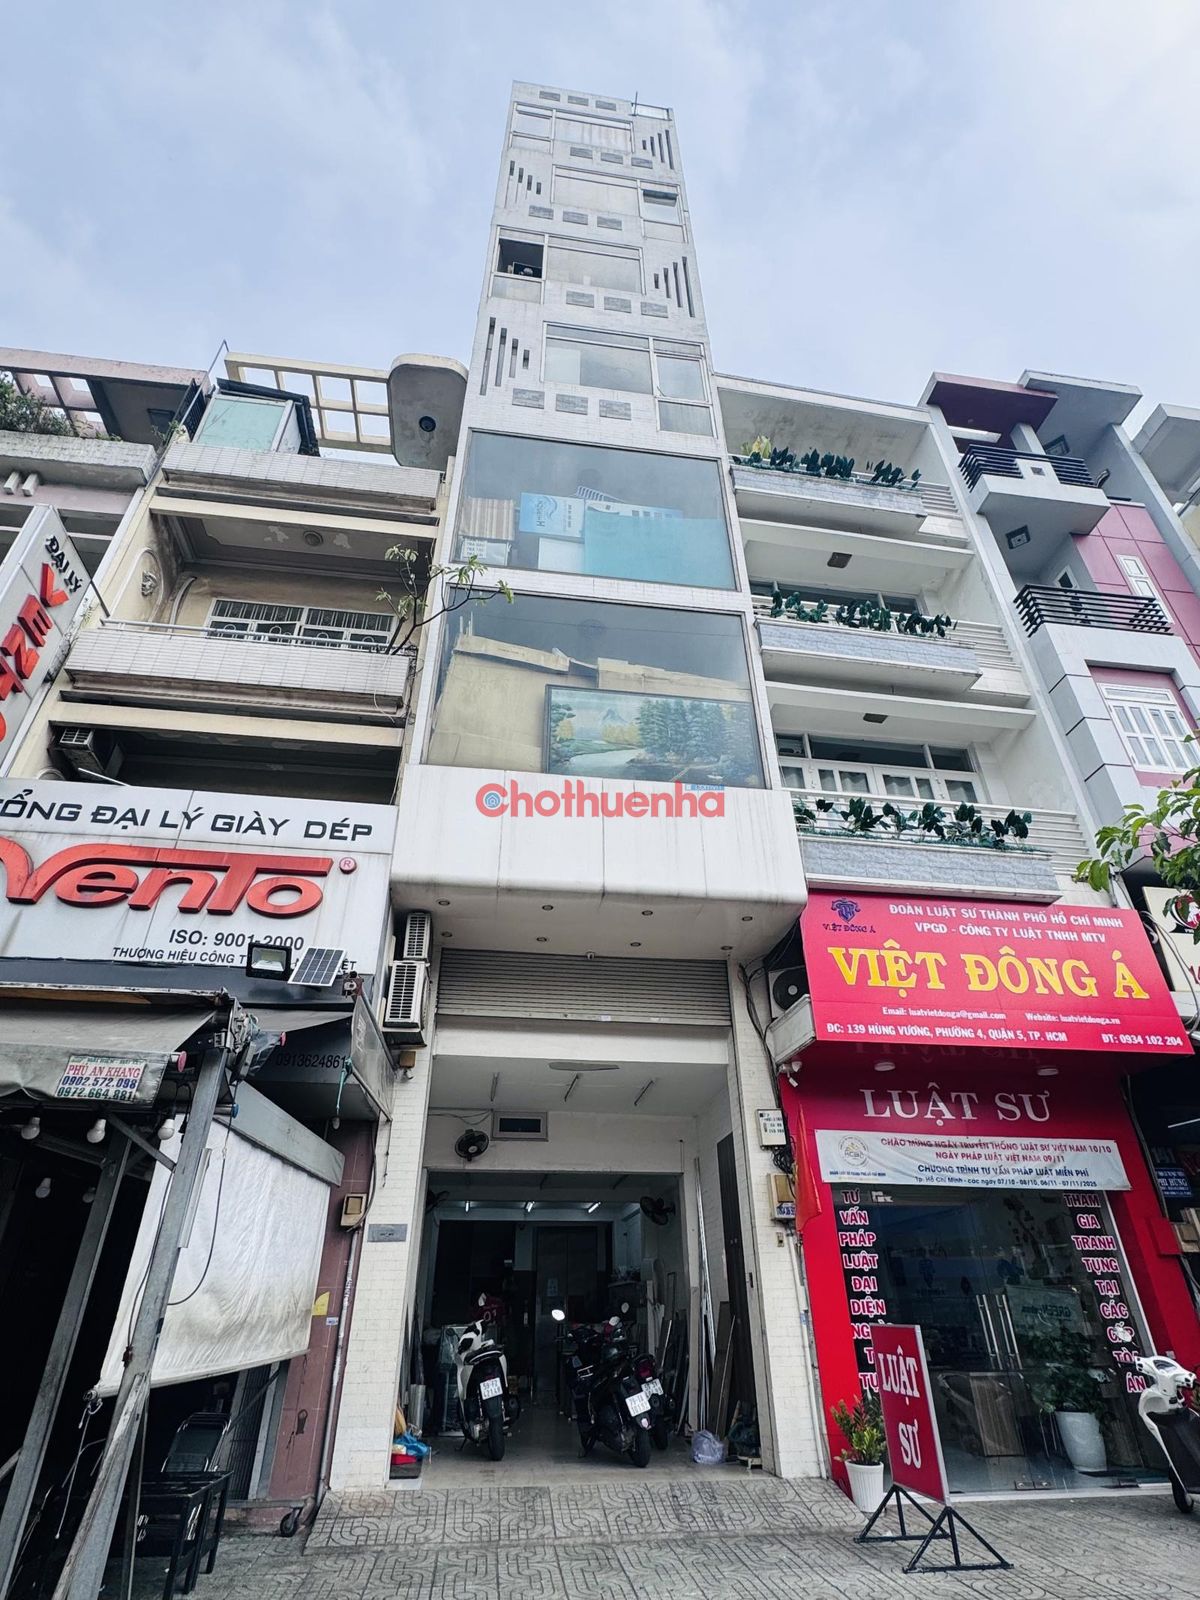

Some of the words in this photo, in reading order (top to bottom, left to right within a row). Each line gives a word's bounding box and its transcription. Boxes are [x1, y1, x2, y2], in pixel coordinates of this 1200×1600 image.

[45, 535, 70, 573] ĐẠI
[63, 570, 83, 594] LÝ
[0, 789, 83, 822] ỔNG
[90, 805, 151, 830] ĐẠI
[159, 806, 205, 830] LÝ
[210, 810, 290, 836] GIÀY
[303, 817, 373, 841] DÉP
[889, 902, 923, 916] ĐOÀN
[927, 904, 956, 919] LUẬT
[979, 908, 1020, 921] THÀNH
[1023, 910, 1047, 923] PHỐ
[1070, 914, 1091, 926] CHÍ
[1093, 917, 1124, 928] MINH
[169, 928, 208, 946] ISO:
[915, 921, 947, 933] VPGD
[959, 924, 991, 936] CÔNG
[993, 927, 1008, 936] TY
[1013, 927, 1042, 941] LUẬT
[1046, 930, 1078, 941] TNHH
[1081, 932, 1106, 943] MTV
[167, 948, 197, 963] HIỆU
[199, 949, 235, 964] CÔNG
[827, 938, 947, 998] VIỆT
[960, 945, 1098, 998] ĐÔNG
[1111, 949, 1150, 999] Á
[882, 1007, 907, 1016] Email:
[1025, 1013, 1059, 1023] Website:
[827, 1023, 844, 1033] ĐC:
[847, 1024, 866, 1034] 139
[868, 1022, 896, 1035] HÙNG
[976, 1029, 987, 1040] 4,
[988, 1027, 1014, 1041] QUẬN
[1016, 1030, 1026, 1041] 5,
[1027, 1031, 1044, 1041] TP.
[1046, 1032, 1068, 1042] HCM
[1101, 1034, 1118, 1044] ĐT:
[1119, 1034, 1144, 1045] 0934
[1145, 1036, 1163, 1046] 102
[1165, 1036, 1183, 1046] 204
[89, 1066, 104, 1077] AN
[105, 1066, 141, 1078] KHANG
[61, 1075, 138, 1090] 0902.572.098
[57, 1086, 133, 1101] 0972.664.881
[859, 1081, 979, 1127] LUẬT
[994, 1090, 1051, 1122] SƯ
[881, 1136, 906, 1147] CHÀO
[1021, 1142, 1038, 1152] LUẬT
[1052, 1143, 1068, 1154] VIỆT
[1069, 1144, 1087, 1152] NAM
[1089, 1145, 1111, 1154] 10/10
[936, 1150, 958, 1160] NGÀY
[961, 1151, 982, 1161] PHÁP
[984, 1152, 1002, 1163] LUẬT
[1005, 1153, 1021, 1163] VIỆT
[1042, 1155, 1065, 1164] 09/11
[918, 1164, 954, 1173] CHƯƠNG
[956, 1164, 979, 1175] TRÌNH
[981, 1166, 991, 1175] TƯ
[1012, 1166, 1033, 1176] PHÁP
[1035, 1166, 1053, 1179] LUẬT
[1055, 1166, 1073, 1177] MIỄN
[1075, 1168, 1089, 1177] PHÍ
[842, 1189, 860, 1204] TƯ
[1064, 1193, 1101, 1208] THAM
[839, 1206, 869, 1225] VẤN
[1076, 1214, 1100, 1229] GIA
[838, 1229, 877, 1247] PHÁP
[1071, 1235, 1118, 1251] TRANH
[842, 1251, 878, 1272] LUẬT
[1082, 1257, 1120, 1275] TỤNG
[851, 1276, 878, 1294] ĐẠI
[1095, 1279, 1120, 1298] TẠI
[850, 1296, 886, 1318] DIỆN
[1100, 1299, 1129, 1319] CÁC
[878, 1344, 920, 1406] LUẬT
[1126, 1372, 1147, 1393] ÁN
[898, 1418, 922, 1469] SƯ
